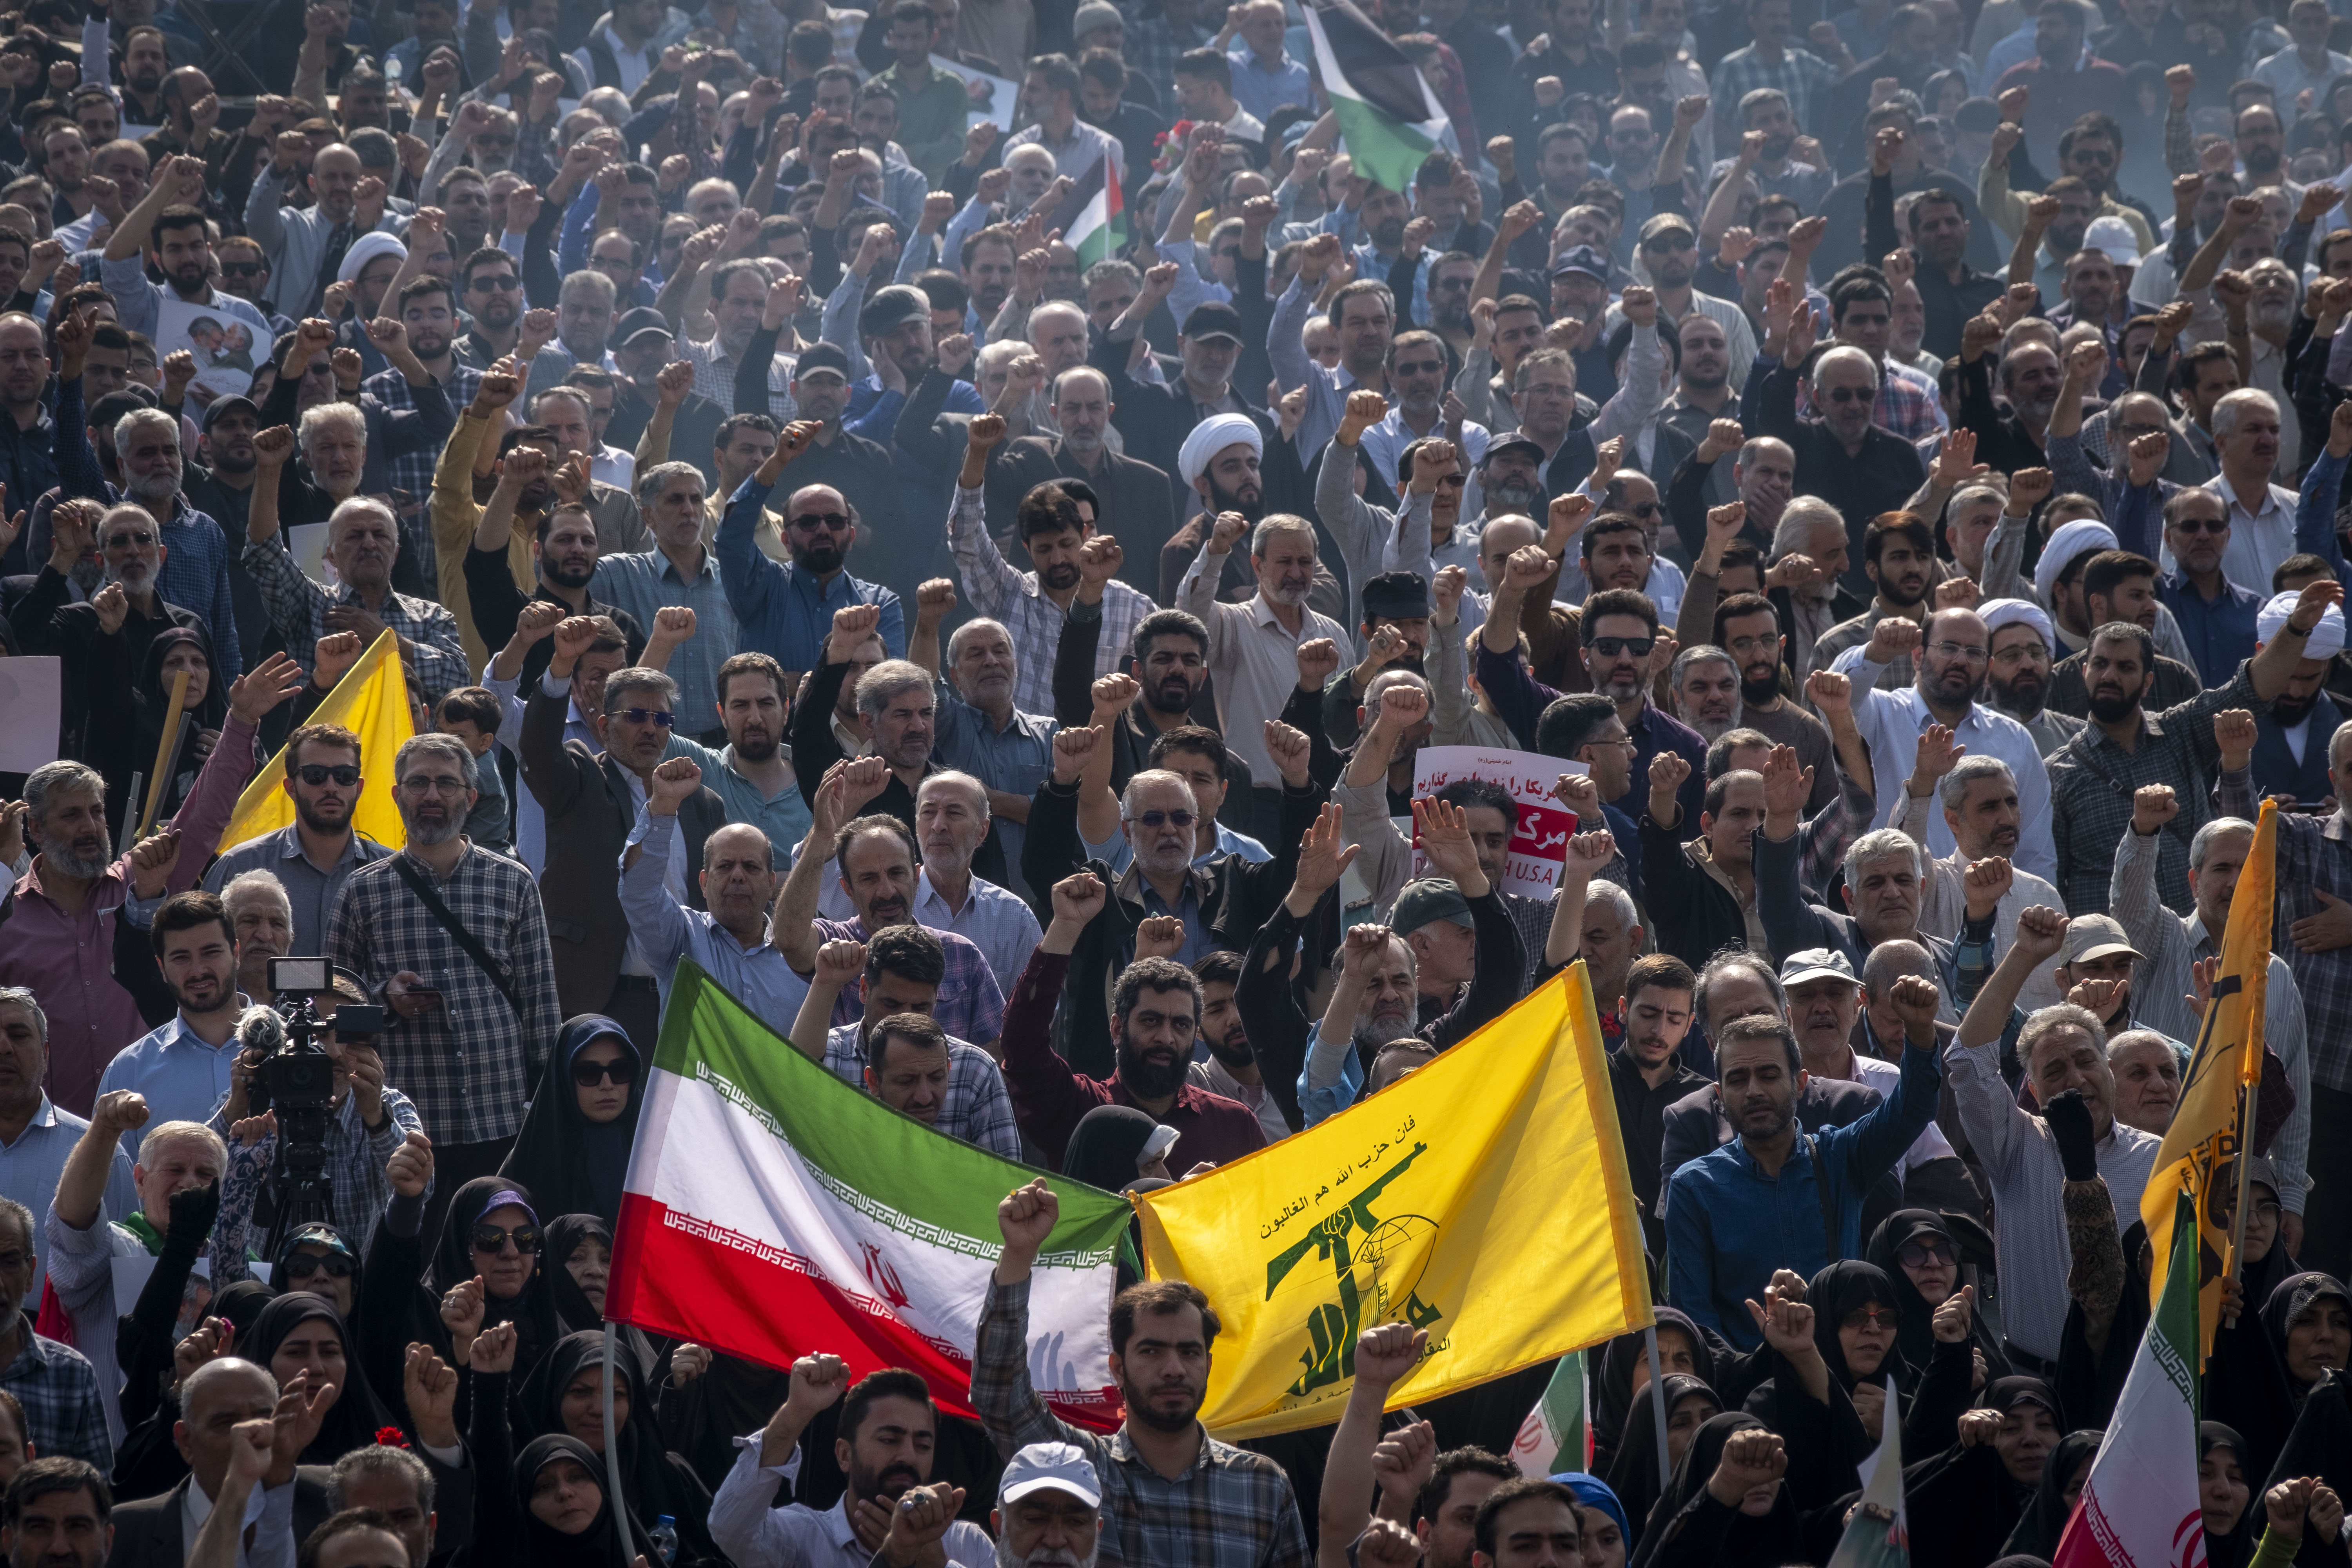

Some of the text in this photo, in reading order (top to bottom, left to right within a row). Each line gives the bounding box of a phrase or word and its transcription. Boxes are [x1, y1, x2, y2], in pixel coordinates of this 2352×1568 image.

[1417, 771, 1448, 794] گذاریم
[1510, 776, 1521, 796] را
[1525, 778, 1557, 802] مریکا
[1514, 813, 1566, 850] مرگ
[1515, 864, 1553, 885] U.S.A
[1358, 1143, 1390, 1169] حزب
[1336, 1164, 1354, 1187] الله
[1315, 1185, 1329, 1207] هم
[1261, 1196, 1308, 1239] الغالبون
[1416, 1337, 1450, 1363] المقاو
